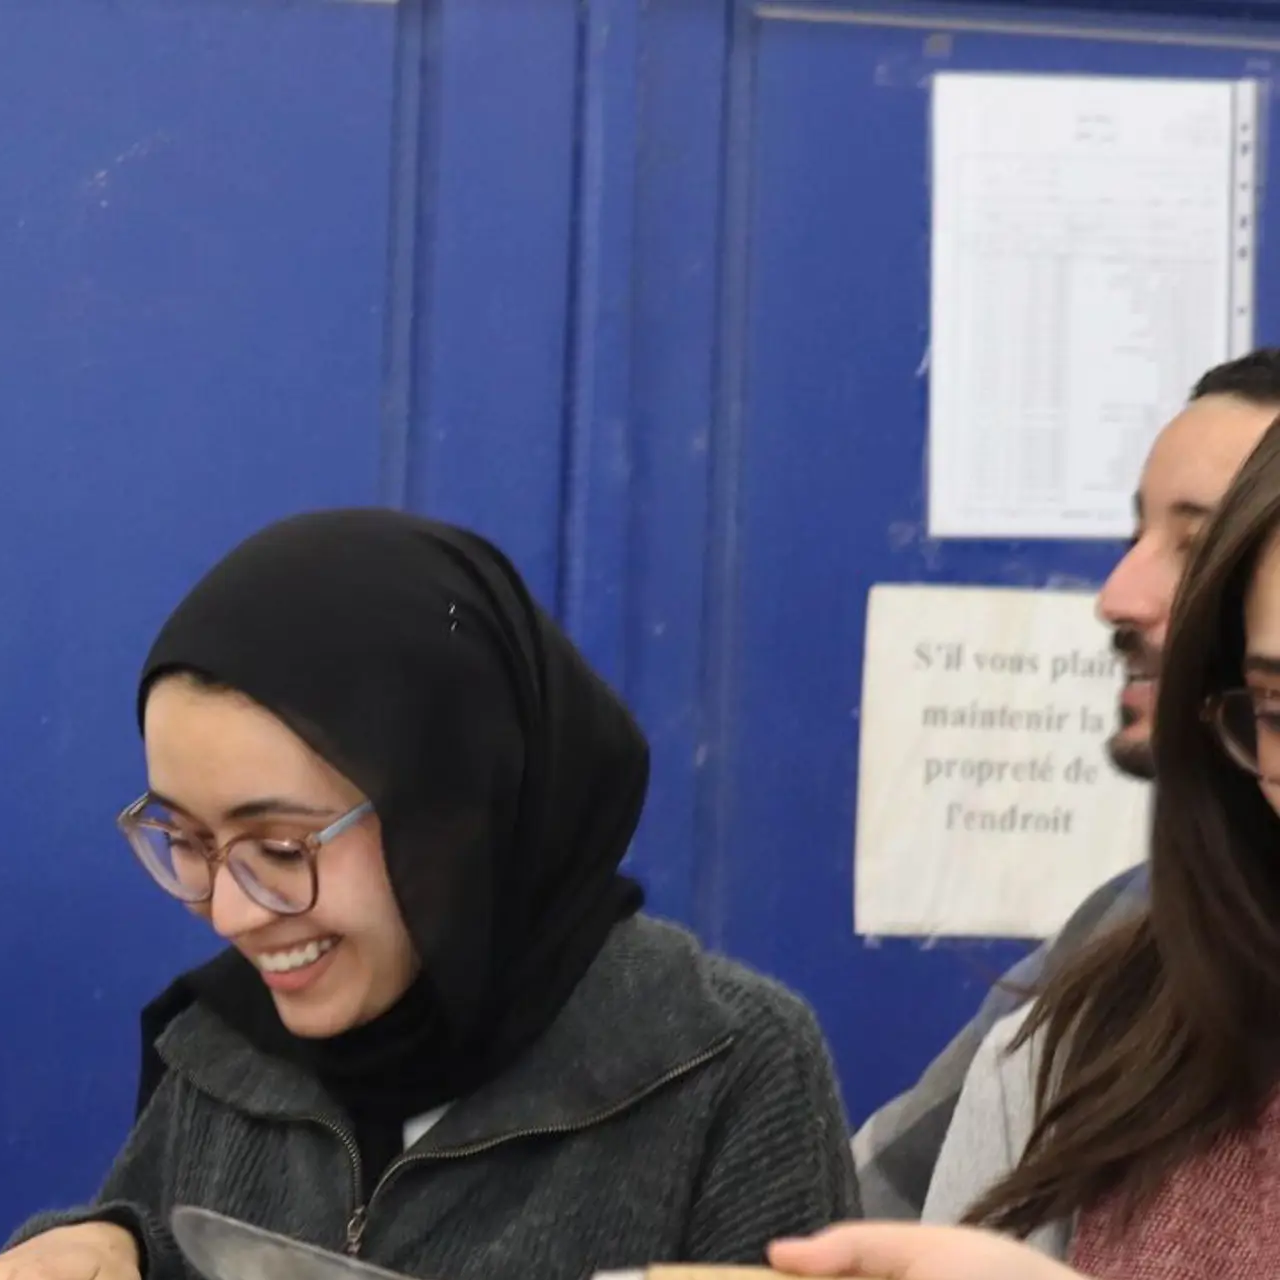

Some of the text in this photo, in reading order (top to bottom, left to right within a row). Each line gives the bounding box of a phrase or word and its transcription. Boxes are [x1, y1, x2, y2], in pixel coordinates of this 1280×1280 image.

[973, 652, 1040, 675] vous
[922, 700, 1105, 734] maintenir la
[924, 752, 1098, 786] propreté de
